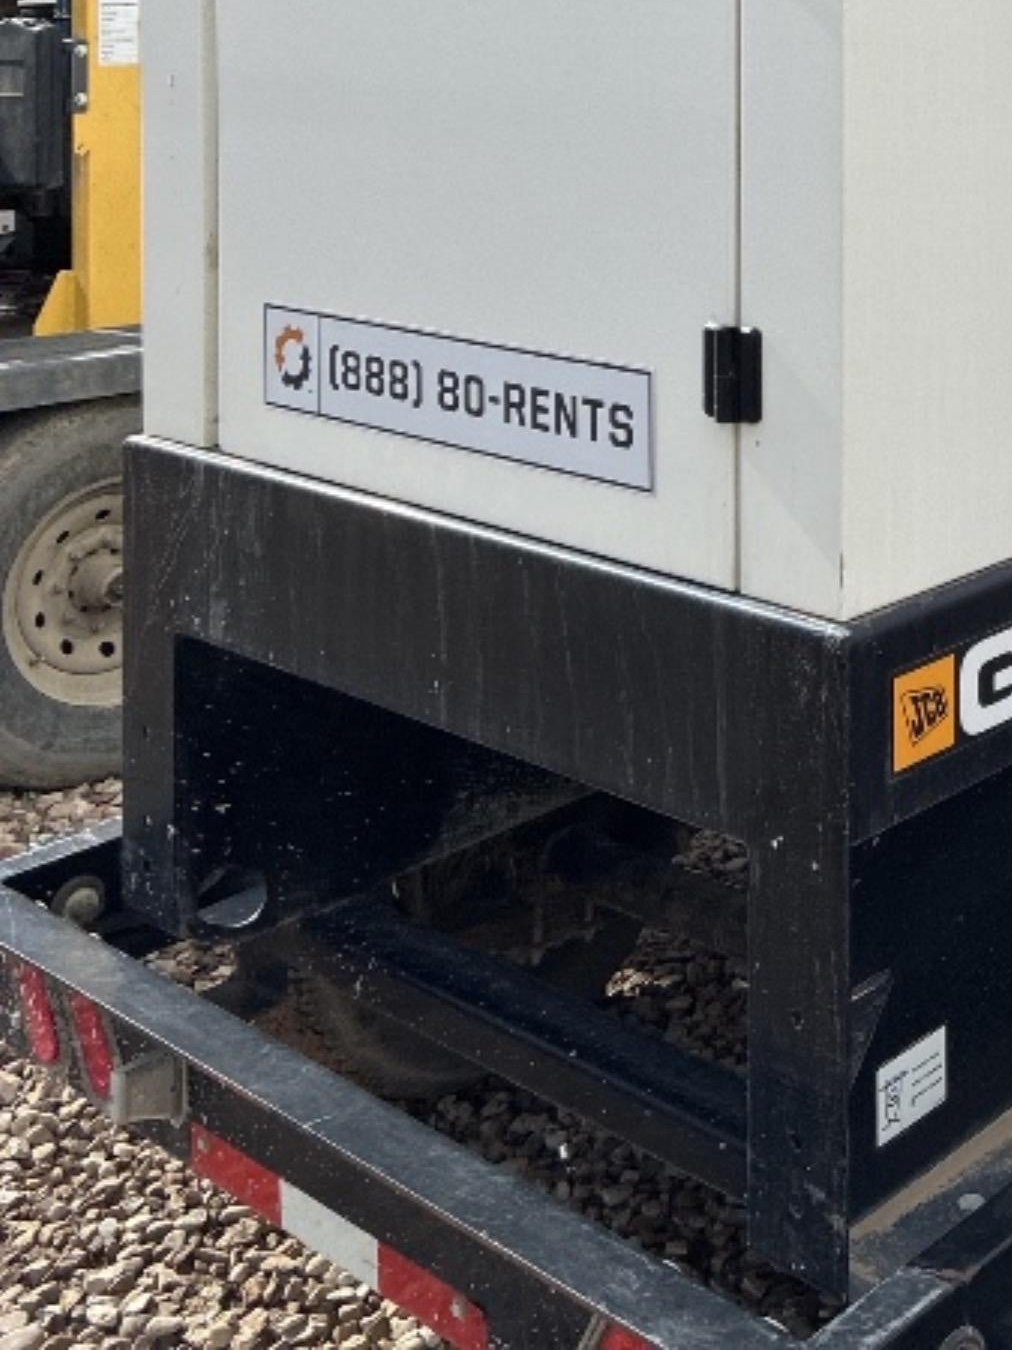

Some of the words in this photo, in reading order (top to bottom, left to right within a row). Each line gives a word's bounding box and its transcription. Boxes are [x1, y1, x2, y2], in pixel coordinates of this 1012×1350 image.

[328, 344, 423, 409] (888)
[437, 368, 635, 449] 80-RENTS
[904, 687, 947, 742] JCB
